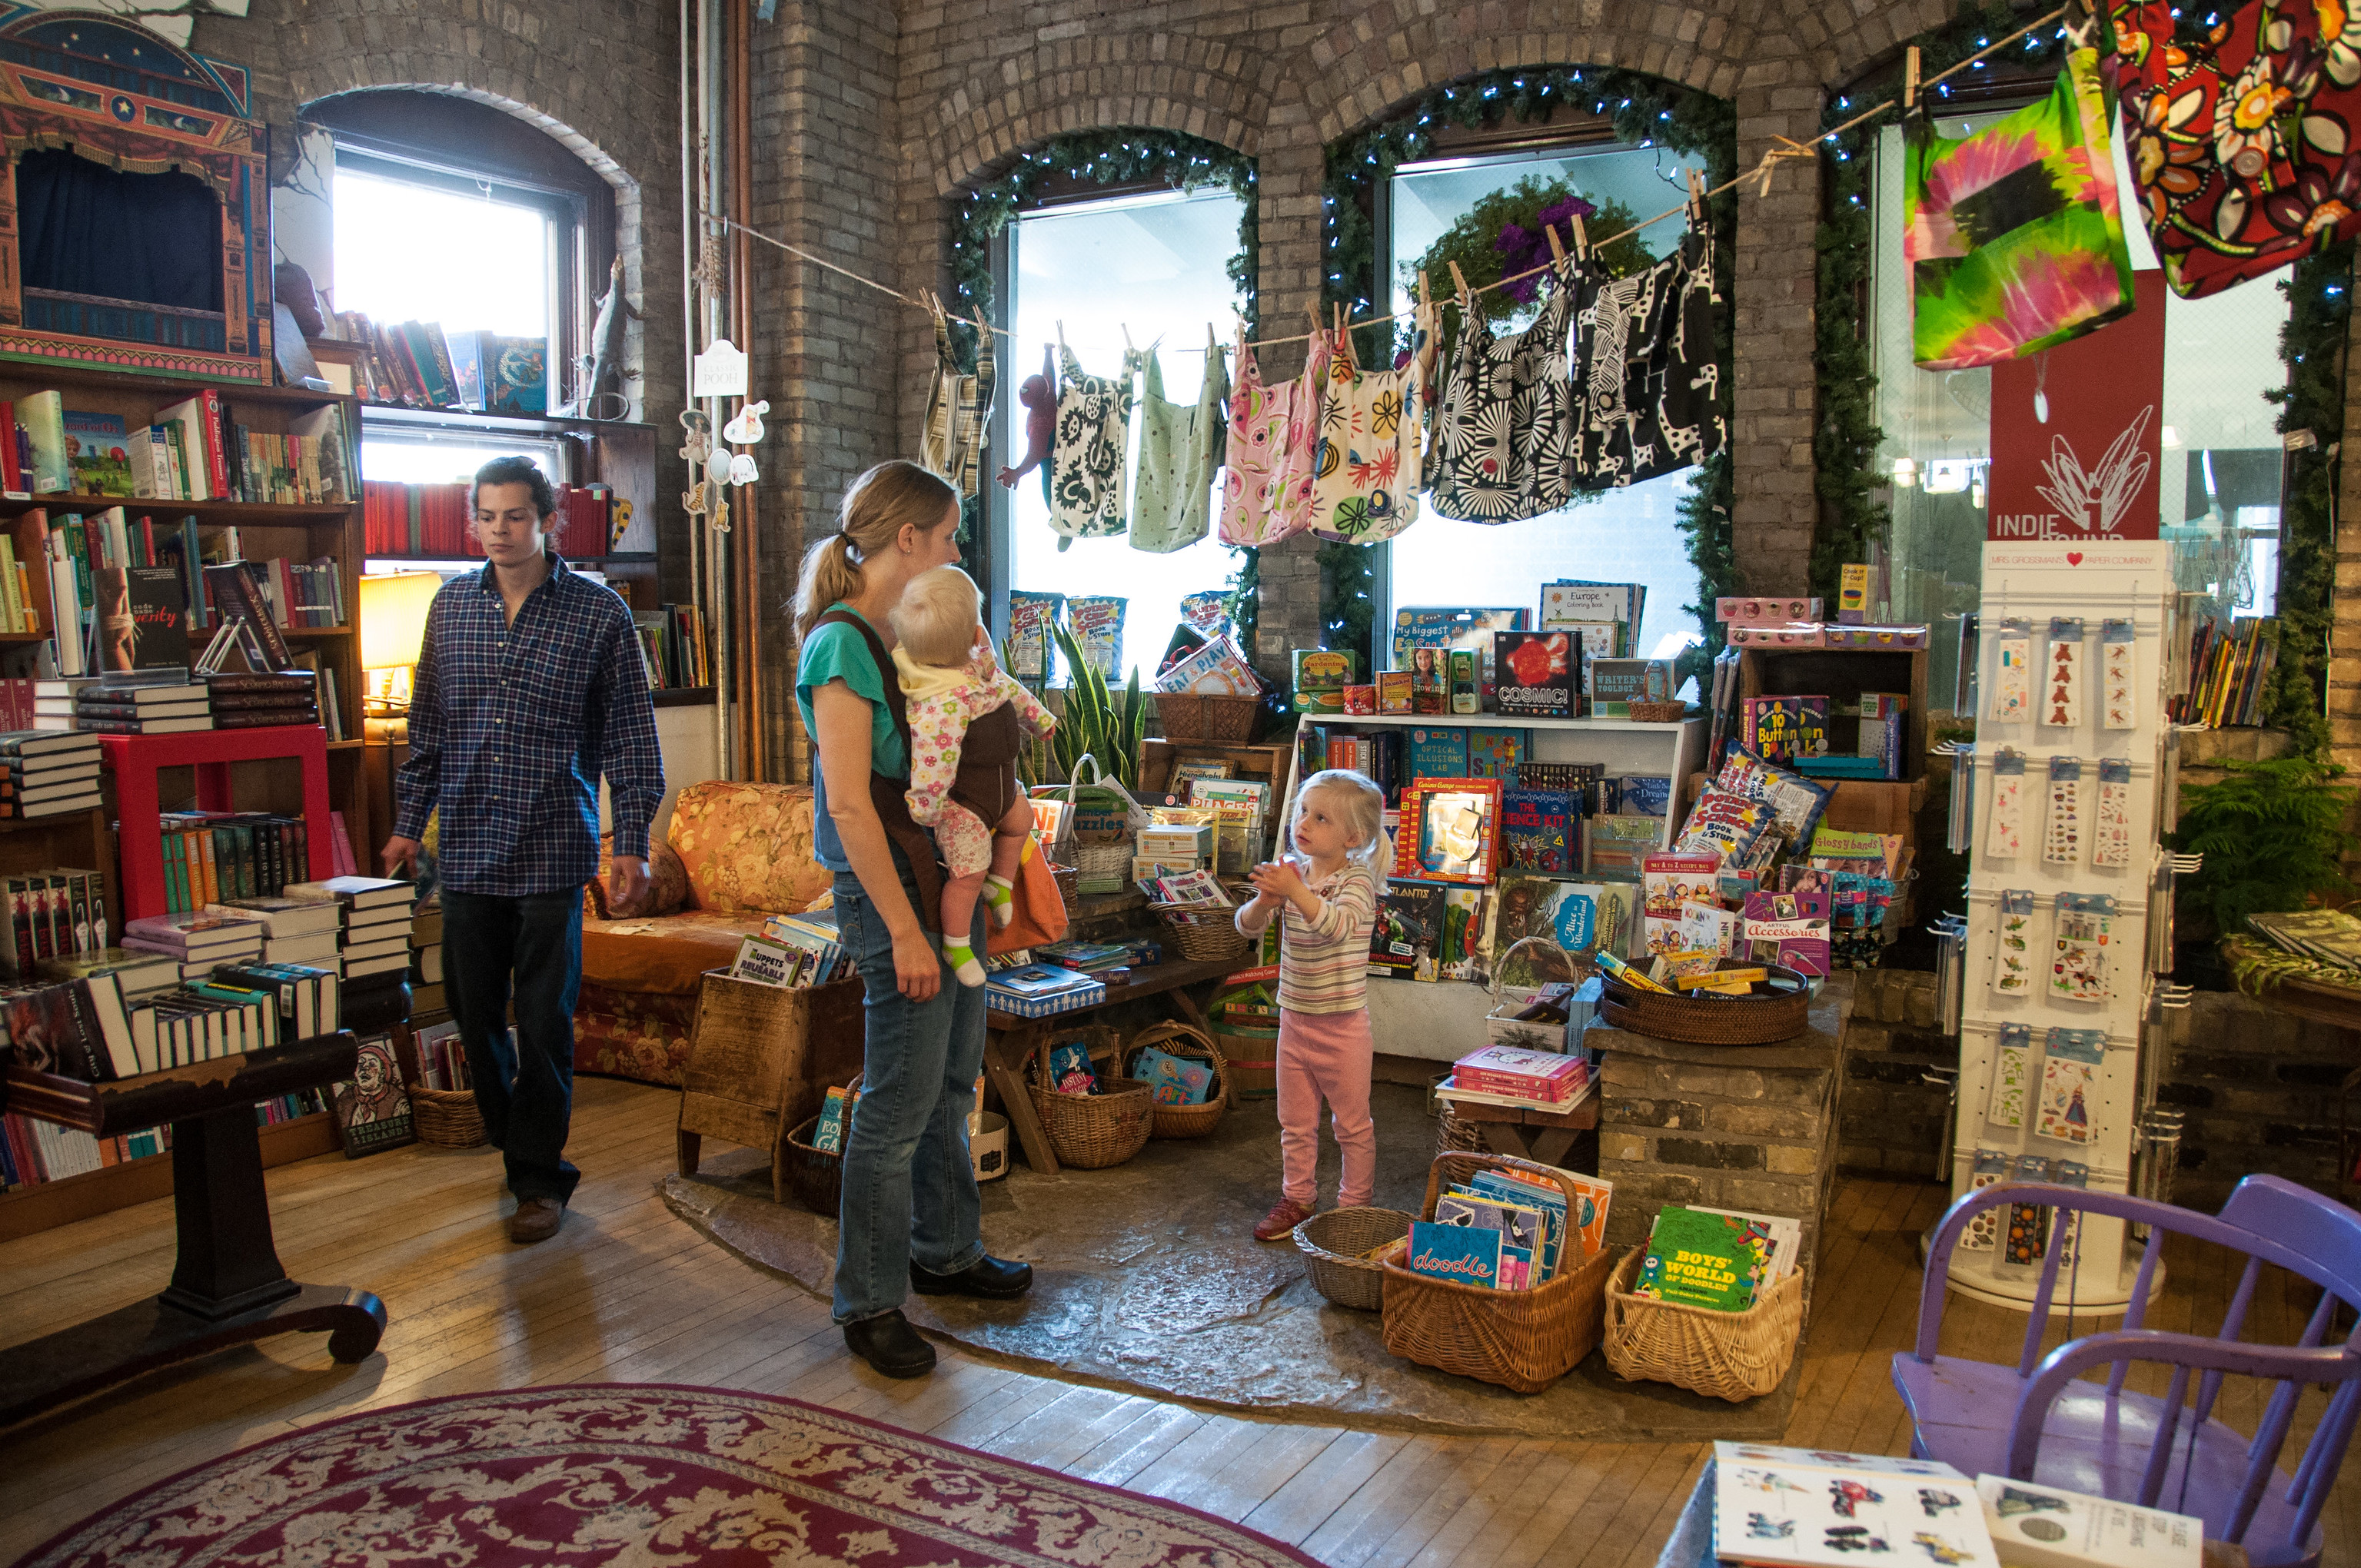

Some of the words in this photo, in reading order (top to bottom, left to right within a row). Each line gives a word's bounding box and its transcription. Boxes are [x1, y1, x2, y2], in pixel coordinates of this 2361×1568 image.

[704, 364, 738, 372] CLASSIC
[704, 373, 738, 385] POOH
[213, 417, 223, 453] Paddington
[1997, 514, 2060, 537] INDIE
[2114, 556, 2152, 565] COMPANY
[1571, 592, 1600, 602] Europe
[1074, 603, 1114, 618] POTATO
[1567, 601, 1590, 610] Coloring
[134, 606, 178, 629] verity
[1085, 610, 1109, 621] CHIP
[1076, 617, 1117, 636] SCIENCE
[1088, 626, 1106, 636] BOOK
[1396, 626, 1410, 636] My
[1412, 626, 1448, 637] Biggest
[1166, 672, 1189, 693] EAT
[1189, 667, 1199, 676] &
[1196, 646, 1227, 673] PLAY
[1385, 678, 1410, 687] Skunked
[1595, 675, 1645, 684] WRITER'S
[1499, 686, 1568, 705] COSMIC!
[1744, 704, 1749, 713] 10
[1771, 713, 1785, 728] 10
[1422, 745, 1458, 754] OPTICAL
[1416, 753, 1464, 764] ILLUSIONS
[1432, 763, 1448, 772] LAB
[1178, 771, 1222, 780] Hieroglyphs
[1438, 782, 1455, 790] George
[1518, 802, 1536, 813] THE
[1701, 794, 1755, 810] POTATO
[1711, 803, 1744, 815] CHIP
[1076, 809, 1114, 817] umber
[1501, 812, 1541, 827] CIENCE
[1545, 815, 1565, 828] KIT
[1073, 818, 1125, 831] uzzles
[1694, 810, 1752, 832] SCIENCE
[1708, 823, 1732, 835] BOOK
[1709, 831, 1735, 843] STUFF
[1814, 837, 1851, 850] Glossy
[1851, 839, 1878, 850] bands
[261, 862, 268, 870] TO
[274, 860, 281, 869] TO
[1565, 912, 1577, 943] Alice
[1574, 899, 1588, 948] Wonderland
[1748, 925, 1821, 938] Accessories
[1719, 922, 1729, 956] MOOMIN
[749, 951, 784, 968] MUPPETS
[740, 960, 785, 981] REUSABLE
[1105, 972, 1124, 984] Magic
[1624, 972, 1648, 992] Curious
[69, 988, 80, 1018] Souls
[77, 1020, 88, 1042] Lost
[1062, 1072, 1087, 1089] INSTANT
[1158, 1086, 1192, 1105] Art
[349, 1116, 410, 1136] TREASURE
[361, 1127, 403, 1144] ISLAND
[1414, 1248, 1494, 1277] doodle
[1675, 1250, 1732, 1269] BOYS'
[1665, 1261, 1737, 1284] WORLD
[1678, 1286, 1708, 1294] AMAZING
[1681, 1277, 1729, 1292] DOODLES
[1665, 1288, 1694, 1299] Full-Color
[1694, 1293, 1720, 1303] Pictures
